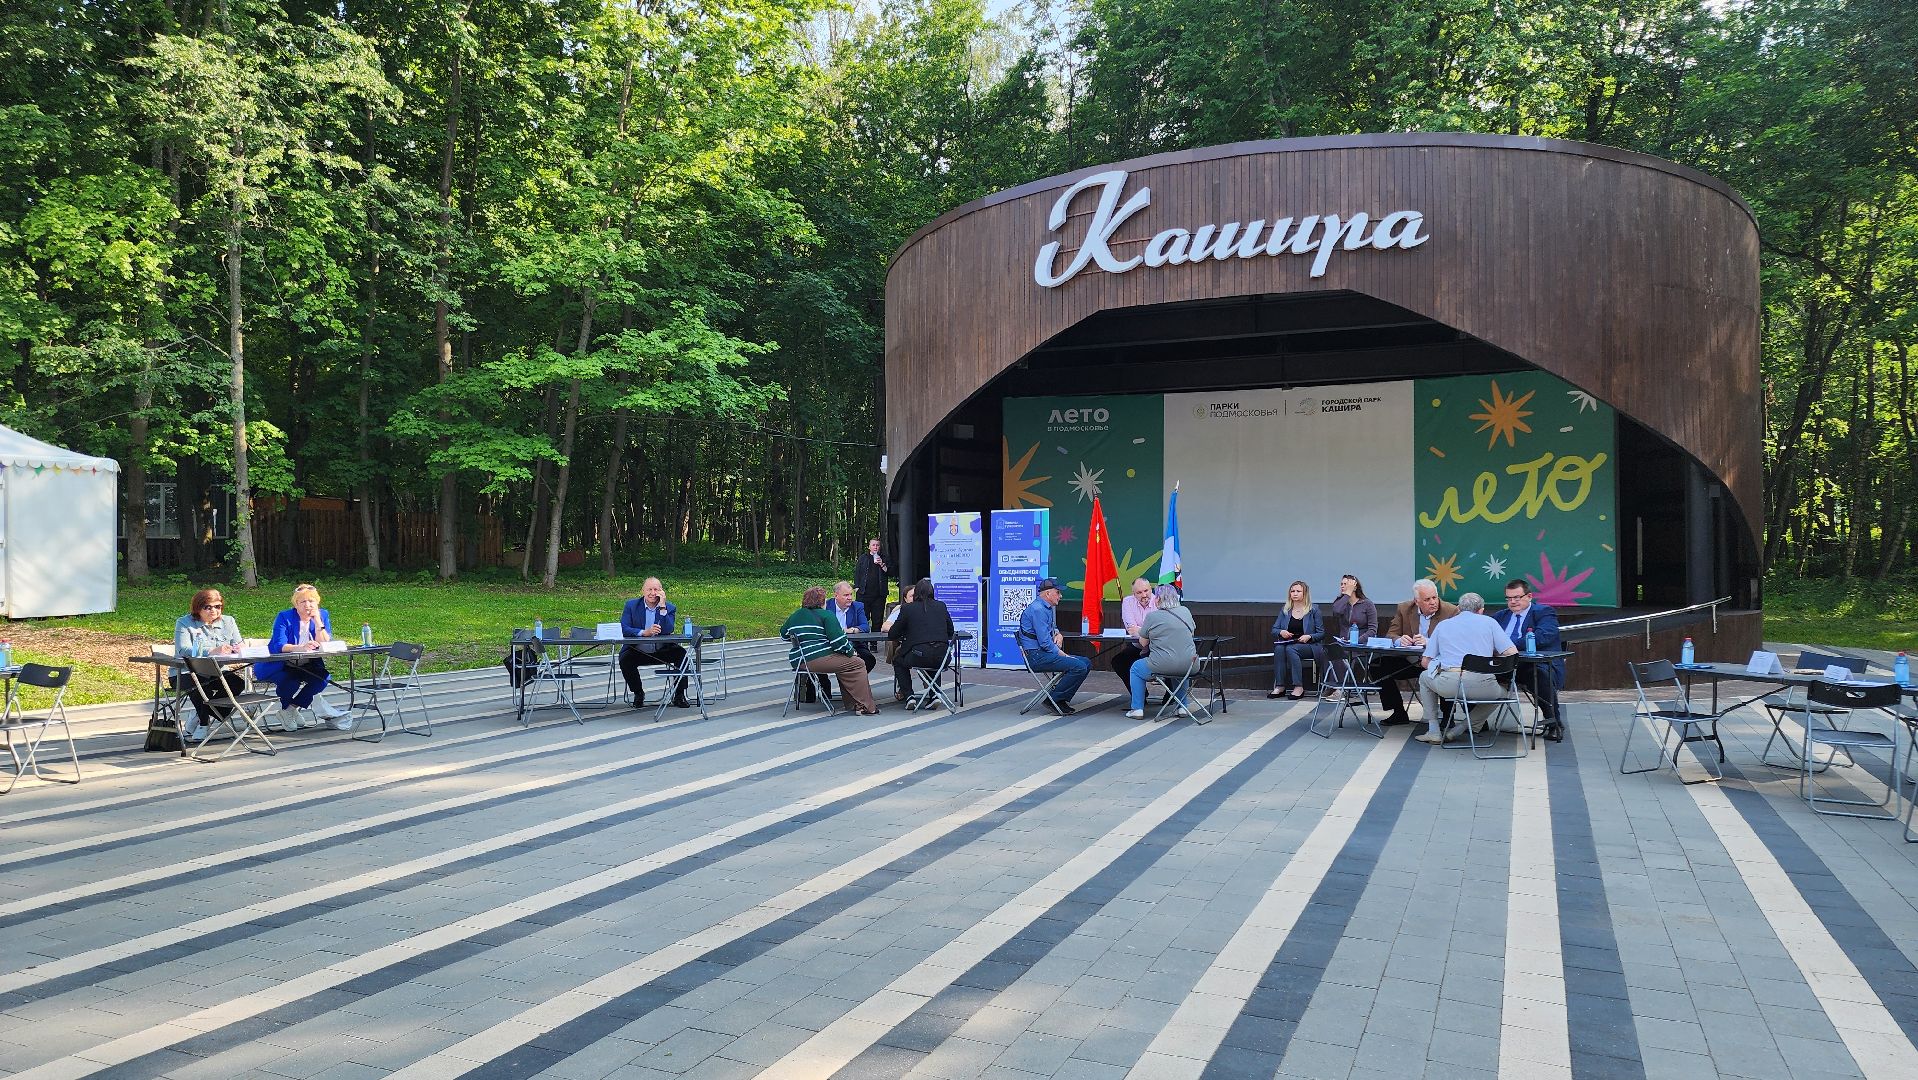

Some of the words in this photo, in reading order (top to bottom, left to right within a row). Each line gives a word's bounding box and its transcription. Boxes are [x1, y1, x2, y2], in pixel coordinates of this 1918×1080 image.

[1034, 169, 1430, 288] Кашира
[1210, 402, 1239, 410] ПАРКИ
[1321, 397, 1363, 406] ГОРОДСКОЙ
[1209, 408, 1278, 418] ПОДМОСКОВЬЯ
[1321, 404, 1362, 413] КАШИРА
[1418, 452, 1608, 529] лето
